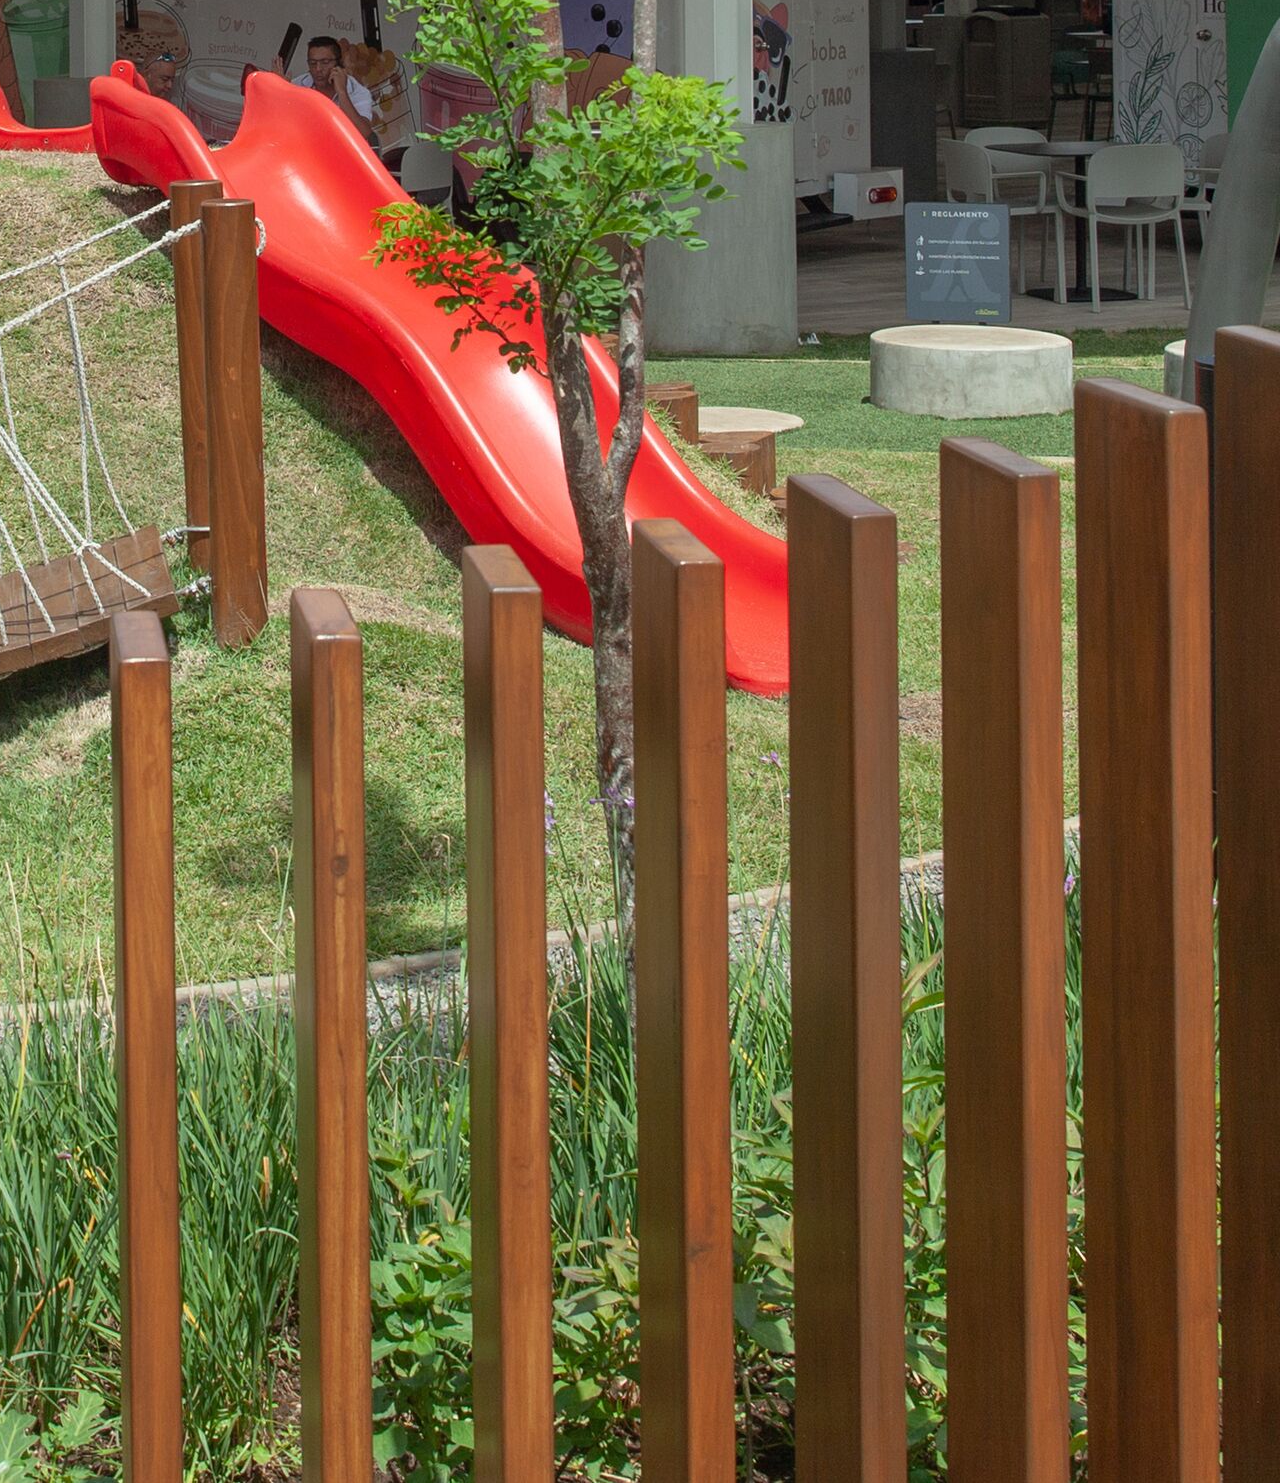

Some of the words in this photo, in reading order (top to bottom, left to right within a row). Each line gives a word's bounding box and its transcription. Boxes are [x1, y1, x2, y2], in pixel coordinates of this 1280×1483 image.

[325, 14, 356, 32] Peach
[811, 37, 848, 62] boba
[821, 86, 852, 107] TARO
[931, 210, 989, 218] REGLAMENTO
